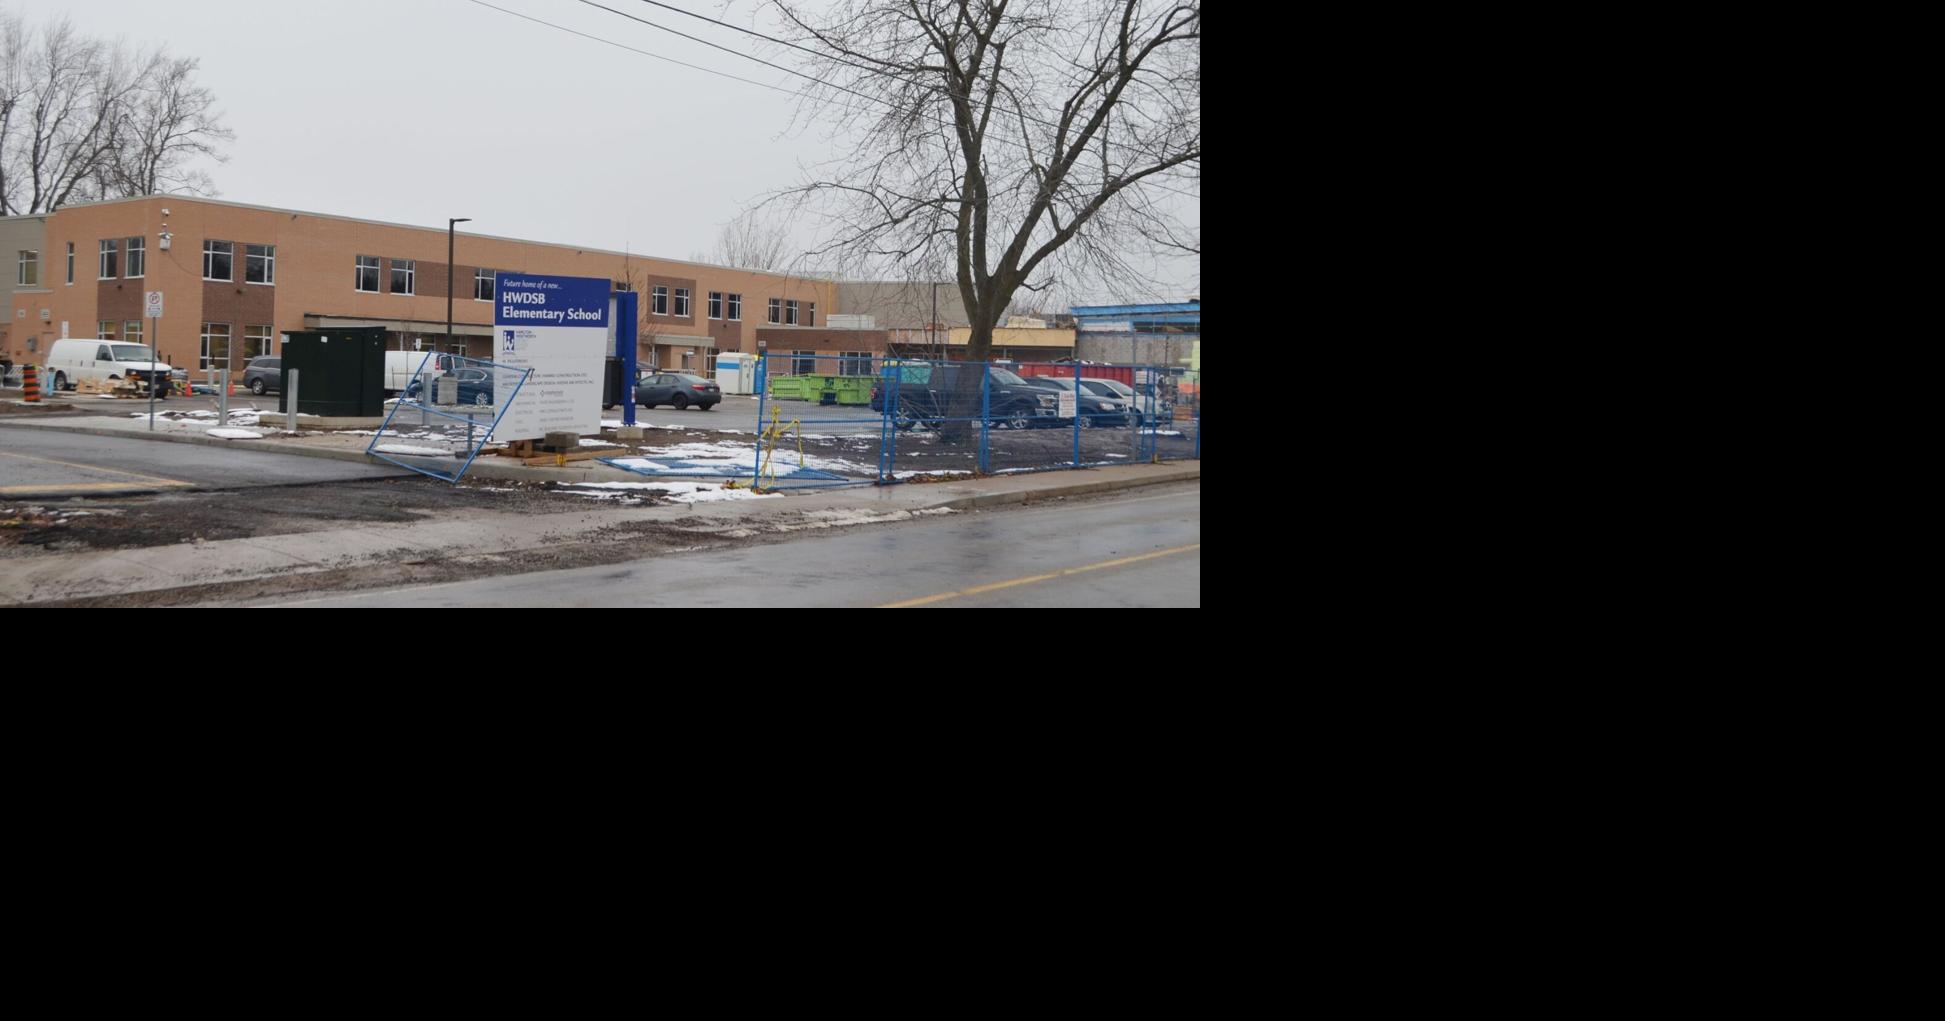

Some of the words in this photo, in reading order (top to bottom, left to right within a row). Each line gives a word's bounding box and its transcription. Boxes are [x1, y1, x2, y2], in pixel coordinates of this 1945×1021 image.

[503, 279, 521, 288] Future
[522, 280, 536, 288] home
[536, 280, 543, 290] of
[503, 292, 546, 304] HWDSB
[503, 306, 565, 324] Elementary
[567, 308, 602, 320] School
